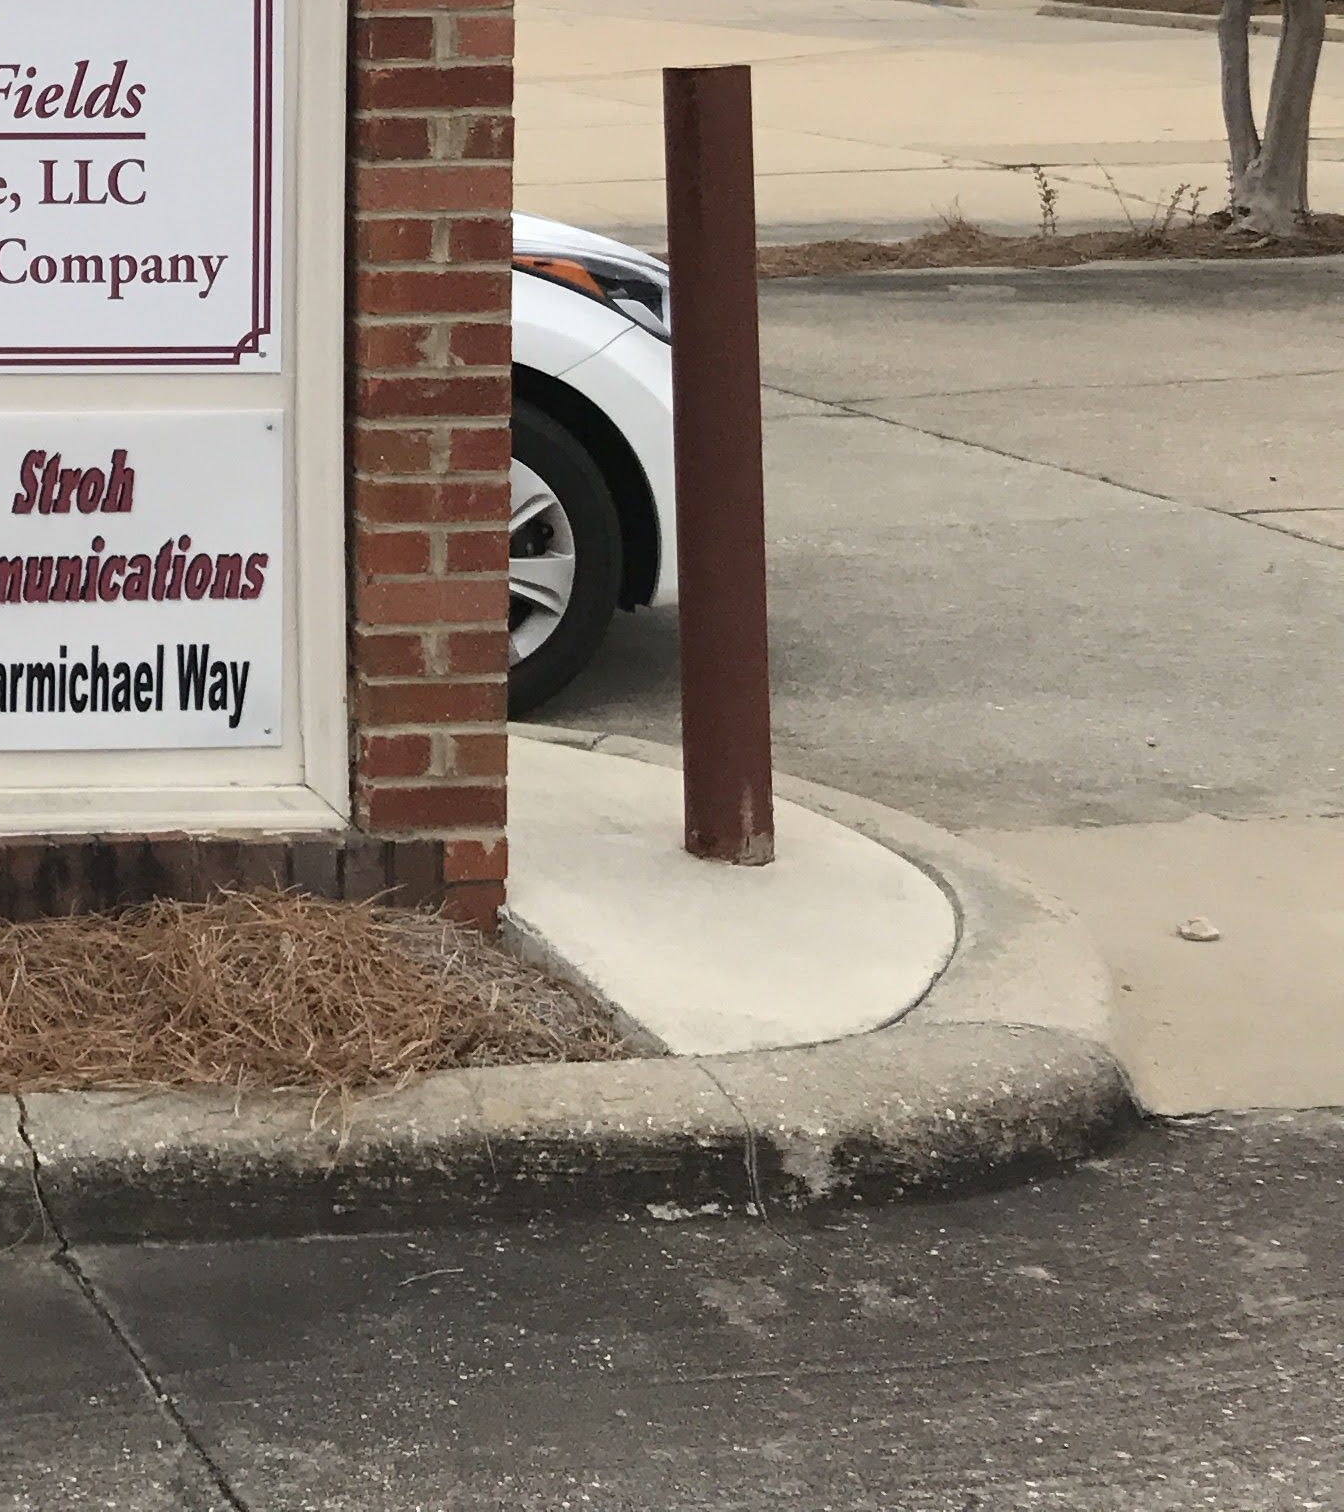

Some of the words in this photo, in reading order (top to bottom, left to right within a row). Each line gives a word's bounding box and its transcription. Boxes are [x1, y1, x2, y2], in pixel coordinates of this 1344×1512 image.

[38, 158, 147, 206] LLC
[11, 448, 135, 516] Stroh
[176, 643, 251, 729] Way
